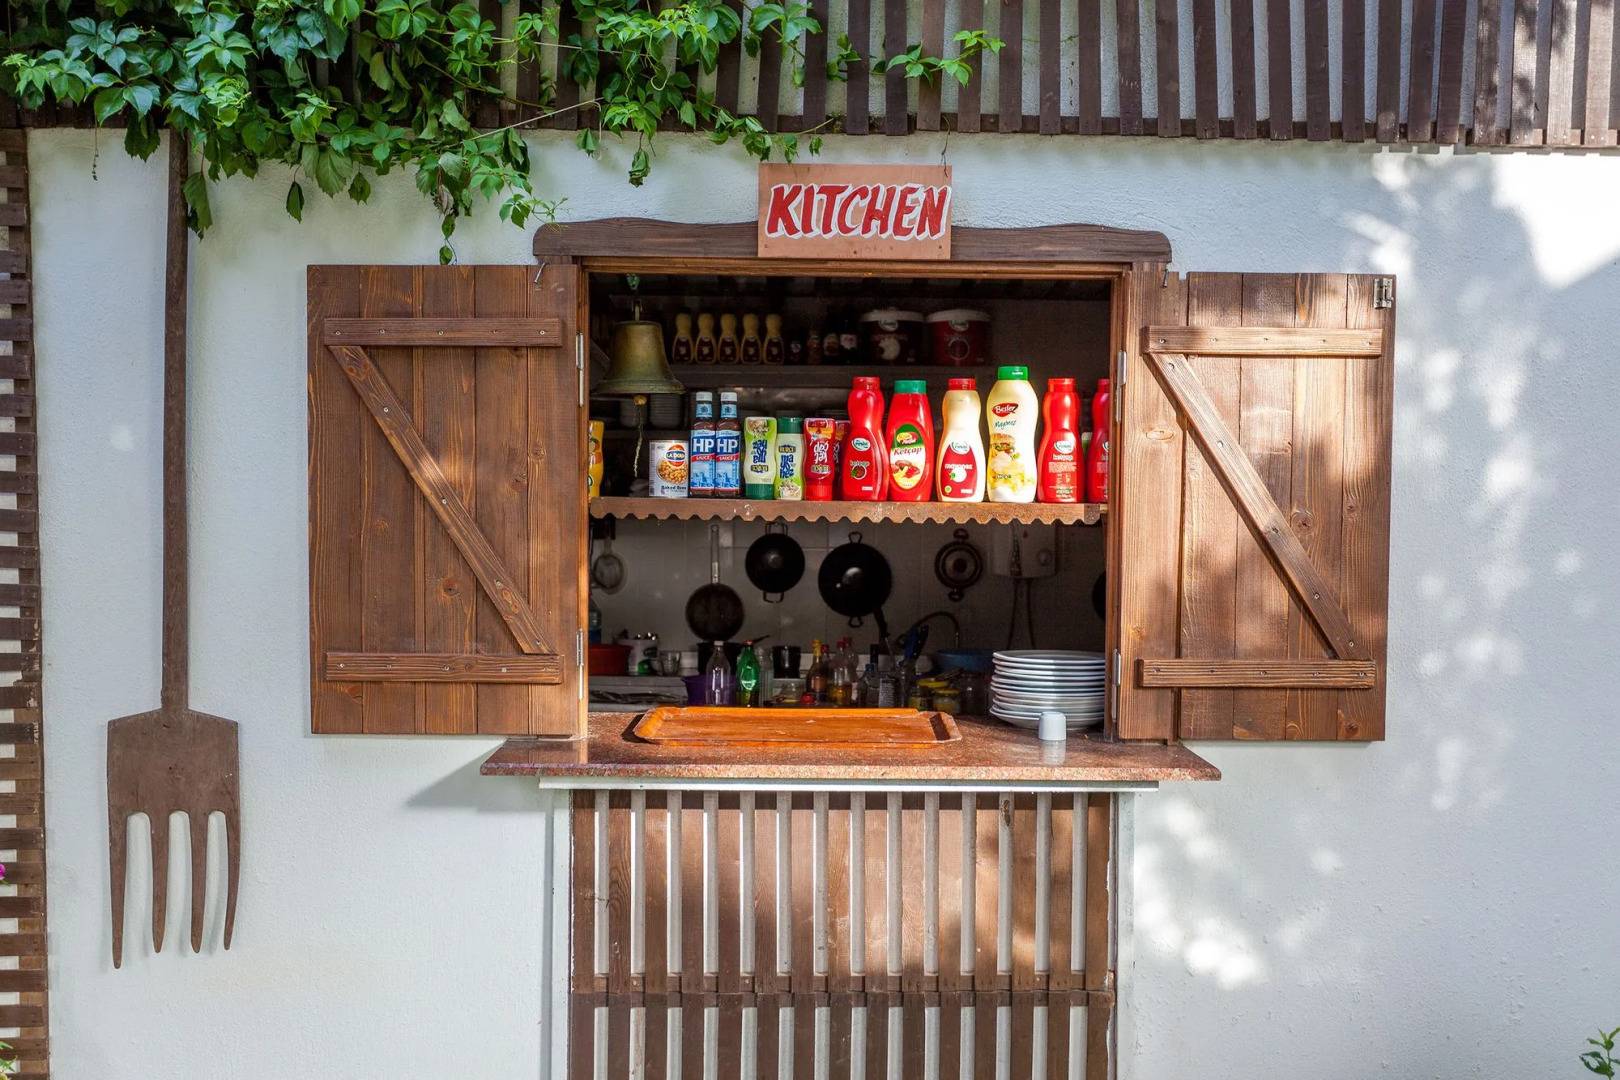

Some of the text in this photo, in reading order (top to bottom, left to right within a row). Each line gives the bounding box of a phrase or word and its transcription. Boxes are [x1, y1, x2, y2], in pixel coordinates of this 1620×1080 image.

[765, 183, 951, 240] KITCHEN
[693, 438, 714, 453] HP
[716, 438, 738, 453] HP
[893, 447, 922, 456] Ketçap
